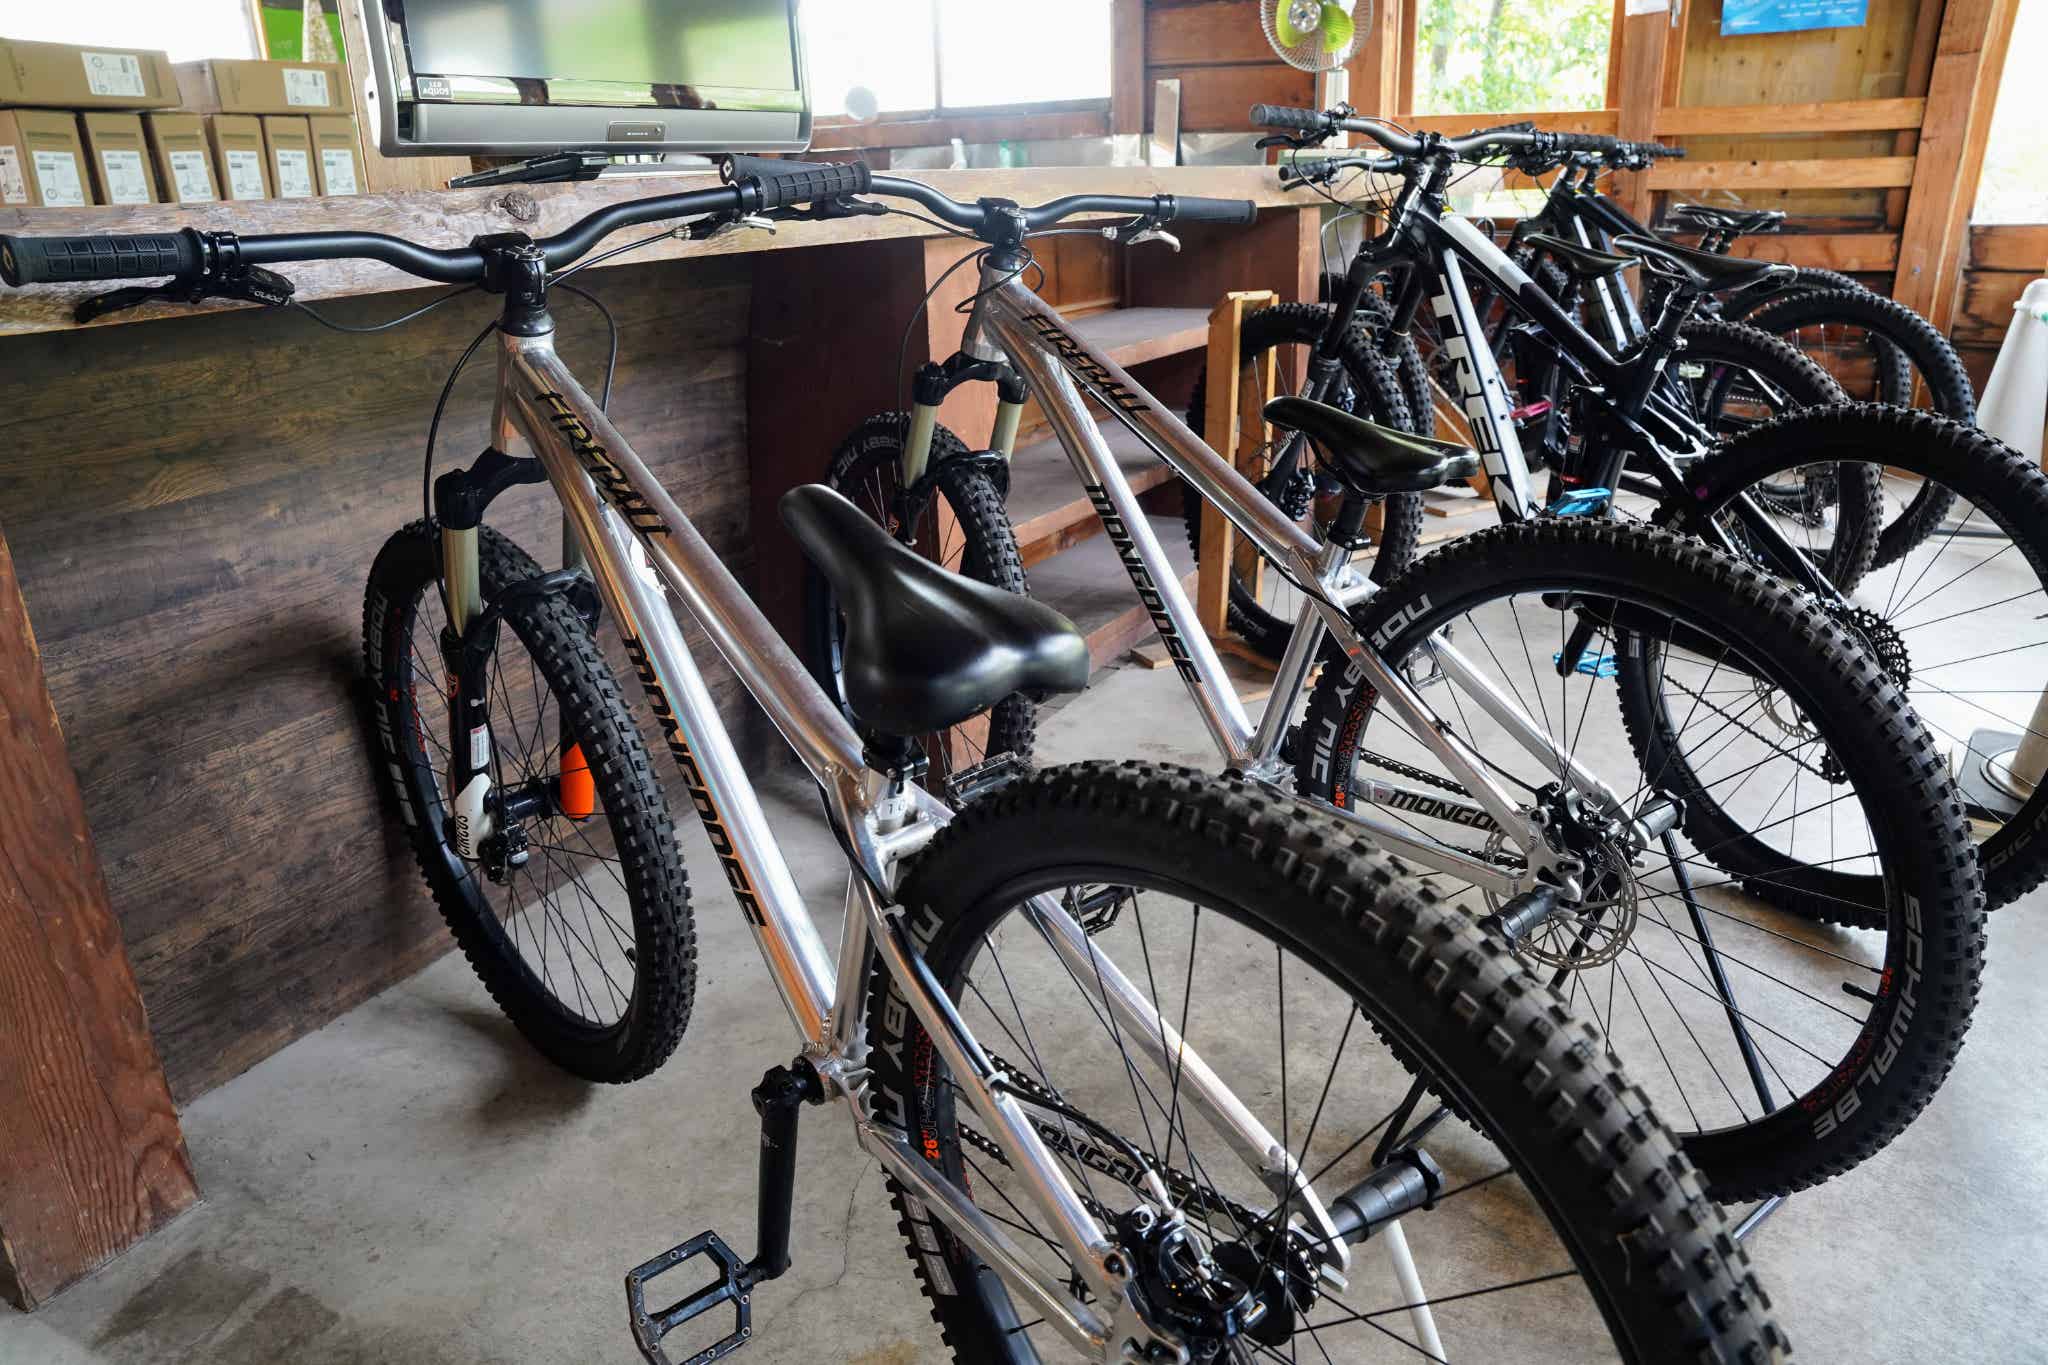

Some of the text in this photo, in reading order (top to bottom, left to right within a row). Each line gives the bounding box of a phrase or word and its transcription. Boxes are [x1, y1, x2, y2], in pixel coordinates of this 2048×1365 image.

[1022, 312, 1152, 415] FIREBALL
[1431, 273, 1525, 520] TREK
[534, 390, 673, 549] FIREBALL
[1085, 482, 1203, 685] MONGOOSE
[624, 636, 768, 928] MONGOOSE
[1389, 789, 1508, 835] MONGO
[1813, 891, 1924, 1140] SCHWALBE
